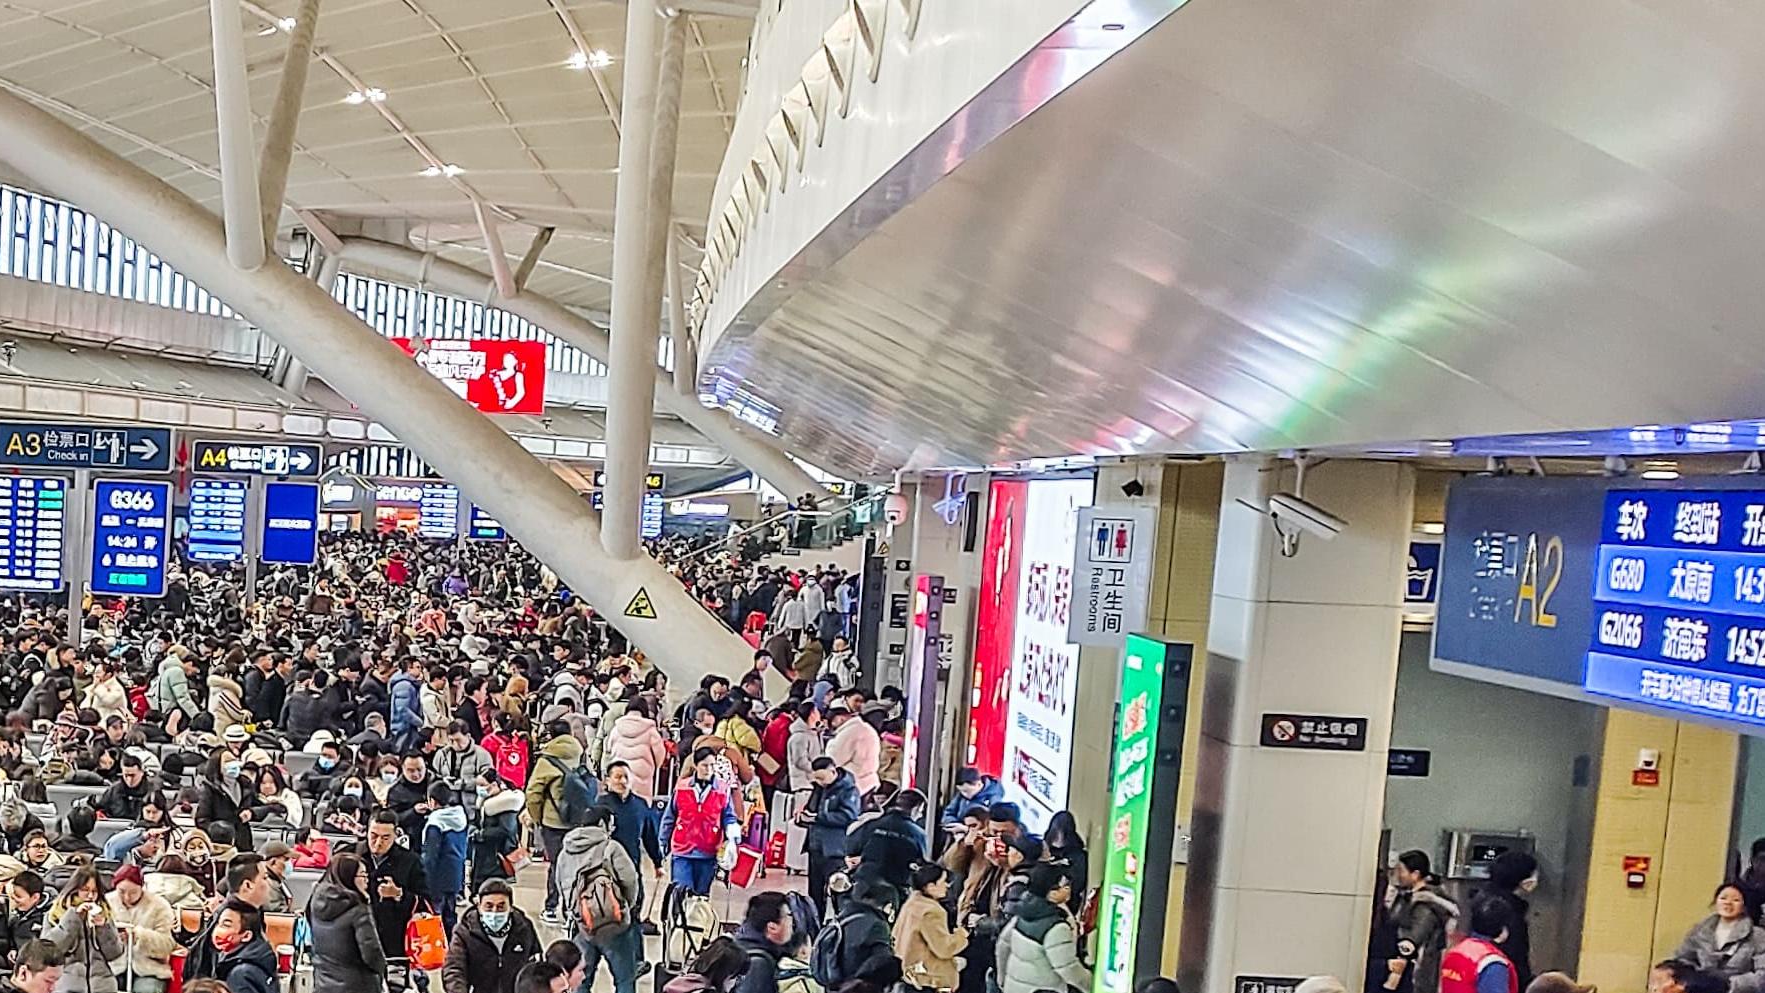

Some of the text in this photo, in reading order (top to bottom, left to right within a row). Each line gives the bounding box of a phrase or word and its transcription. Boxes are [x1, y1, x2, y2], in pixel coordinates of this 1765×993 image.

[6, 430, 89, 456] A3 检票口
[48, 449, 89, 461] Check in
[200, 448, 227, 467] A4
[1615, 500, 1649, 541] 车次
[1514, 533, 1563, 627] A2
[1609, 557, 1646, 592] G680
[1087, 566, 1104, 633] Restrooms
[1102, 567, 1126, 634] 卫生间
[1598, 611, 1644, 648] G2066
